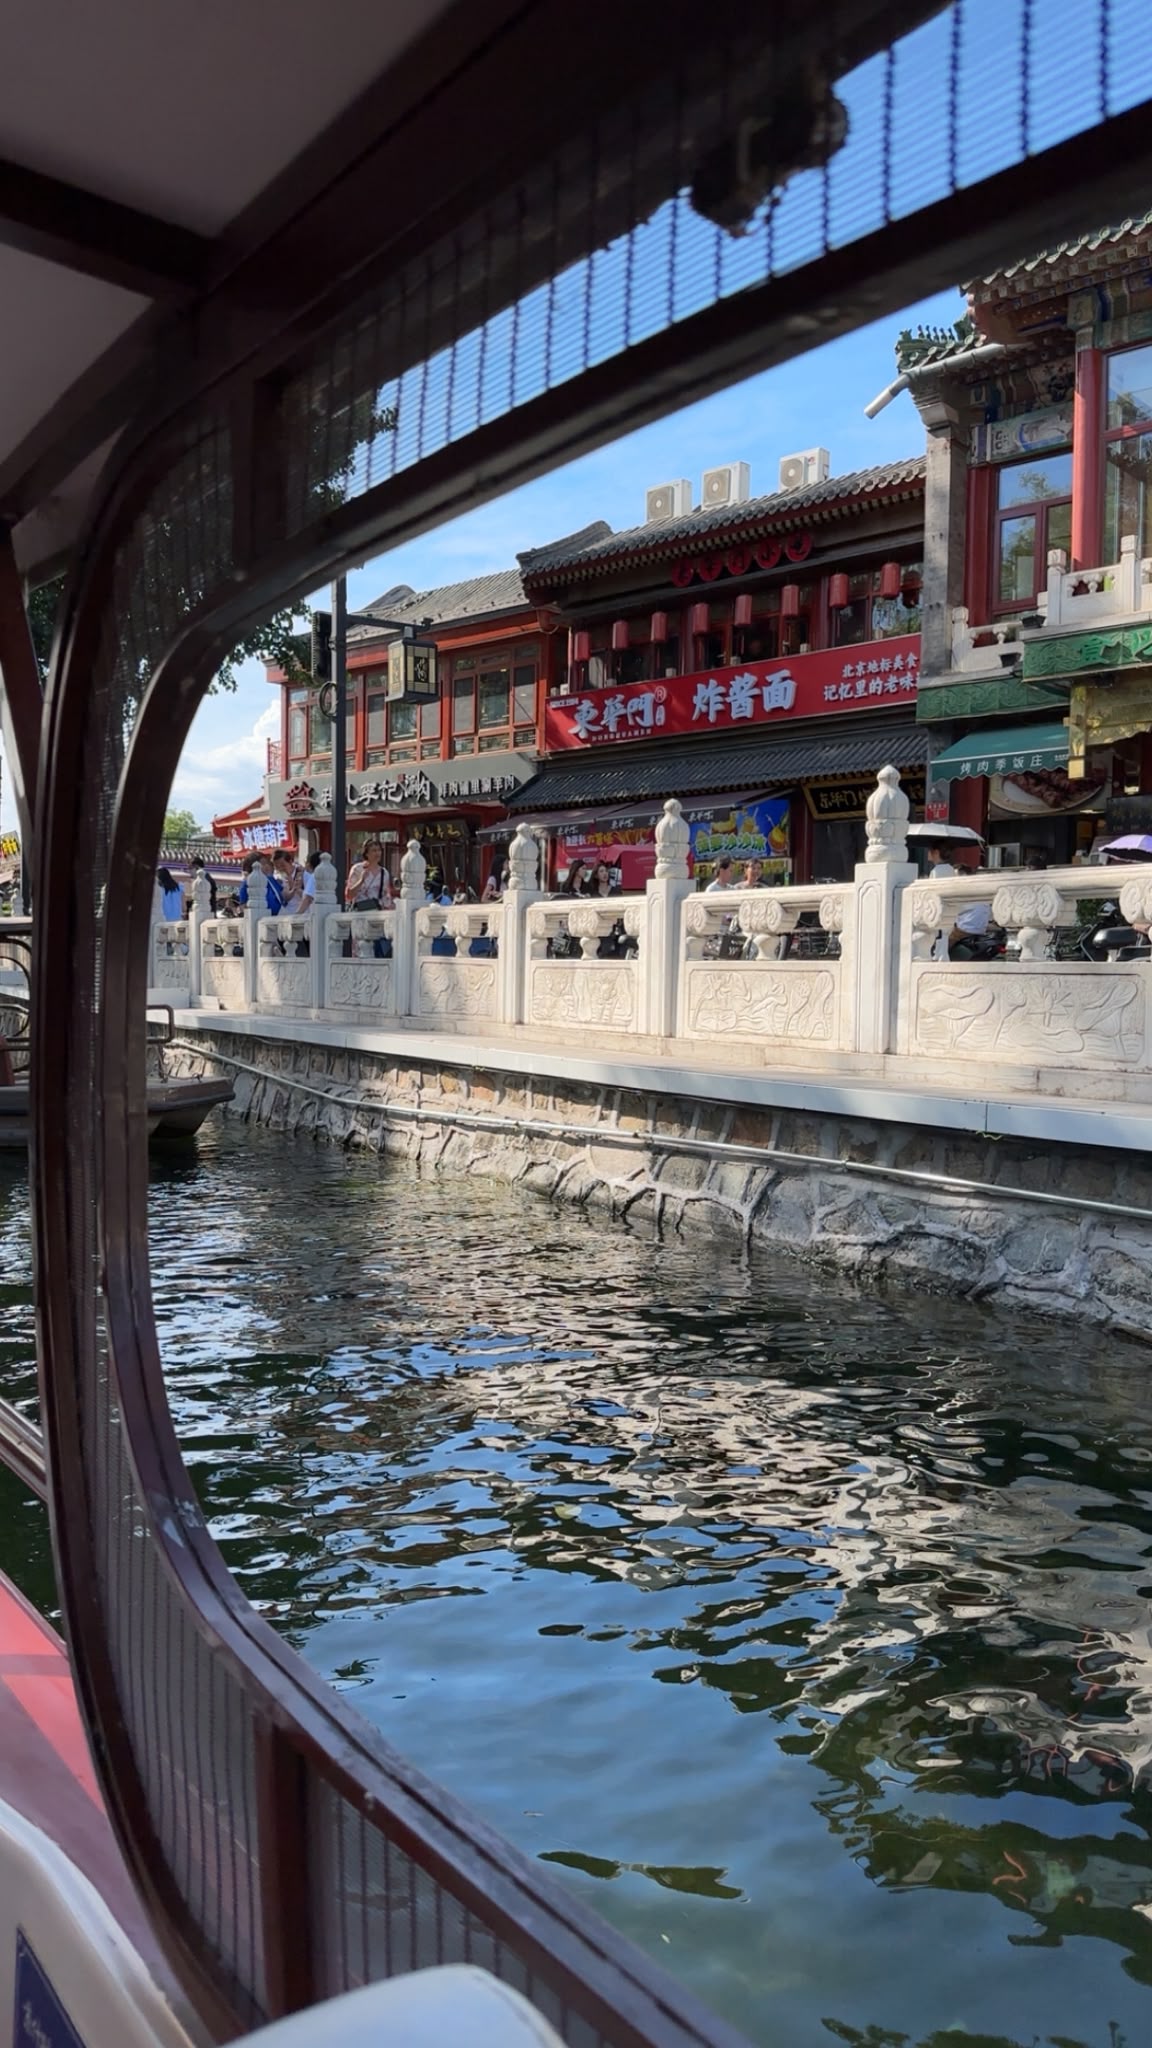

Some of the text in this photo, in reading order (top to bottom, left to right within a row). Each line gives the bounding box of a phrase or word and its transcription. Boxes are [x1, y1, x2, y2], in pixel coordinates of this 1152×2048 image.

[842, 652, 918, 678] 北京地标美食
[691, 668, 797, 723] 炸酱面
[823, 672, 920, 701] 记忆里的老味
[959, 754, 1044, 776] 烤肉季饭庄
